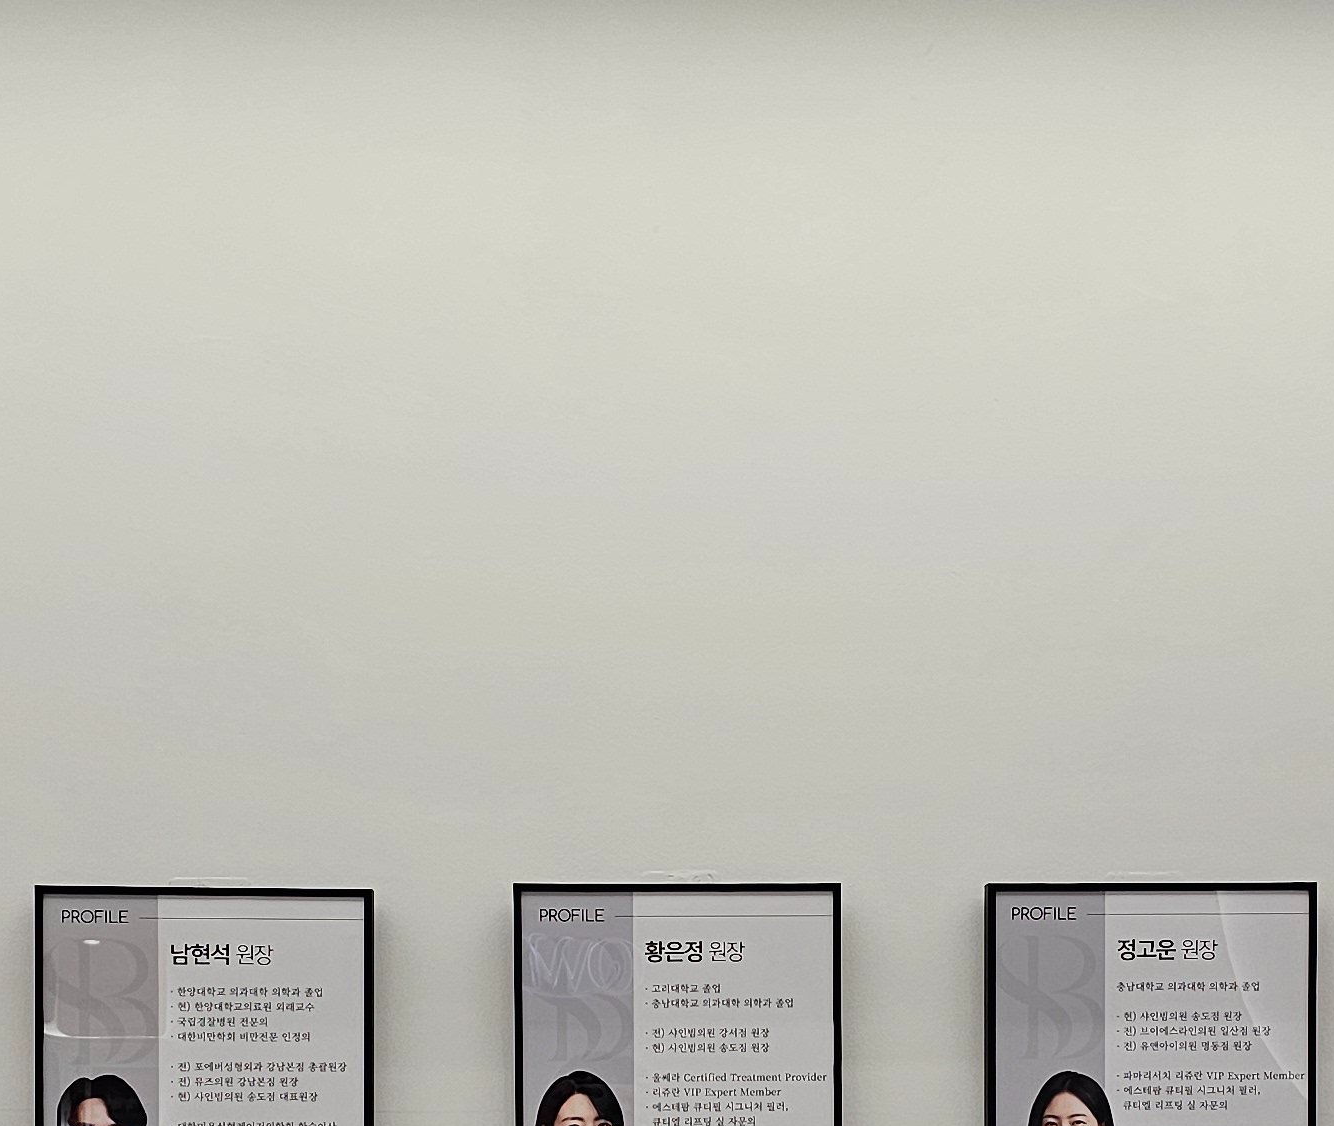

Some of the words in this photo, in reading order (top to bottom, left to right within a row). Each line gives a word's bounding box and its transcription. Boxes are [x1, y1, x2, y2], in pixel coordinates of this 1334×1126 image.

[62, 910, 129, 923] PROFILE
[540, 909, 605, 922] PROFILE
[1012, 907, 1077, 920] PROFILE
[171, 943, 229, 965] 남현석
[236, 945, 274, 965] 원장
[645, 941, 702, 963] 황은정
[709, 941, 745, 962] 원장
[1118, 939, 1176, 961] 정고운
[1181, 940, 1218, 960] 원장
[1224, 1011, 1242, 1022] 원장
[751, 1027, 769, 1038] 원장
[1253, 1026, 1271, 1036] 원장
[684, 1072, 726, 1082] Certified
[730, 1073, 781, 1082] Treatment
[786, 1072, 827, 1081] Provider
[1207, 1071, 1224, 1080] VIP
[1228, 1072, 1260, 1083] Expert
[1264, 1071, 1305, 1080] Member
[684, 1088, 701, 1096] VIP
[705, 1088, 737, 1099] Expert
[741, 1087, 782, 1096] Member
